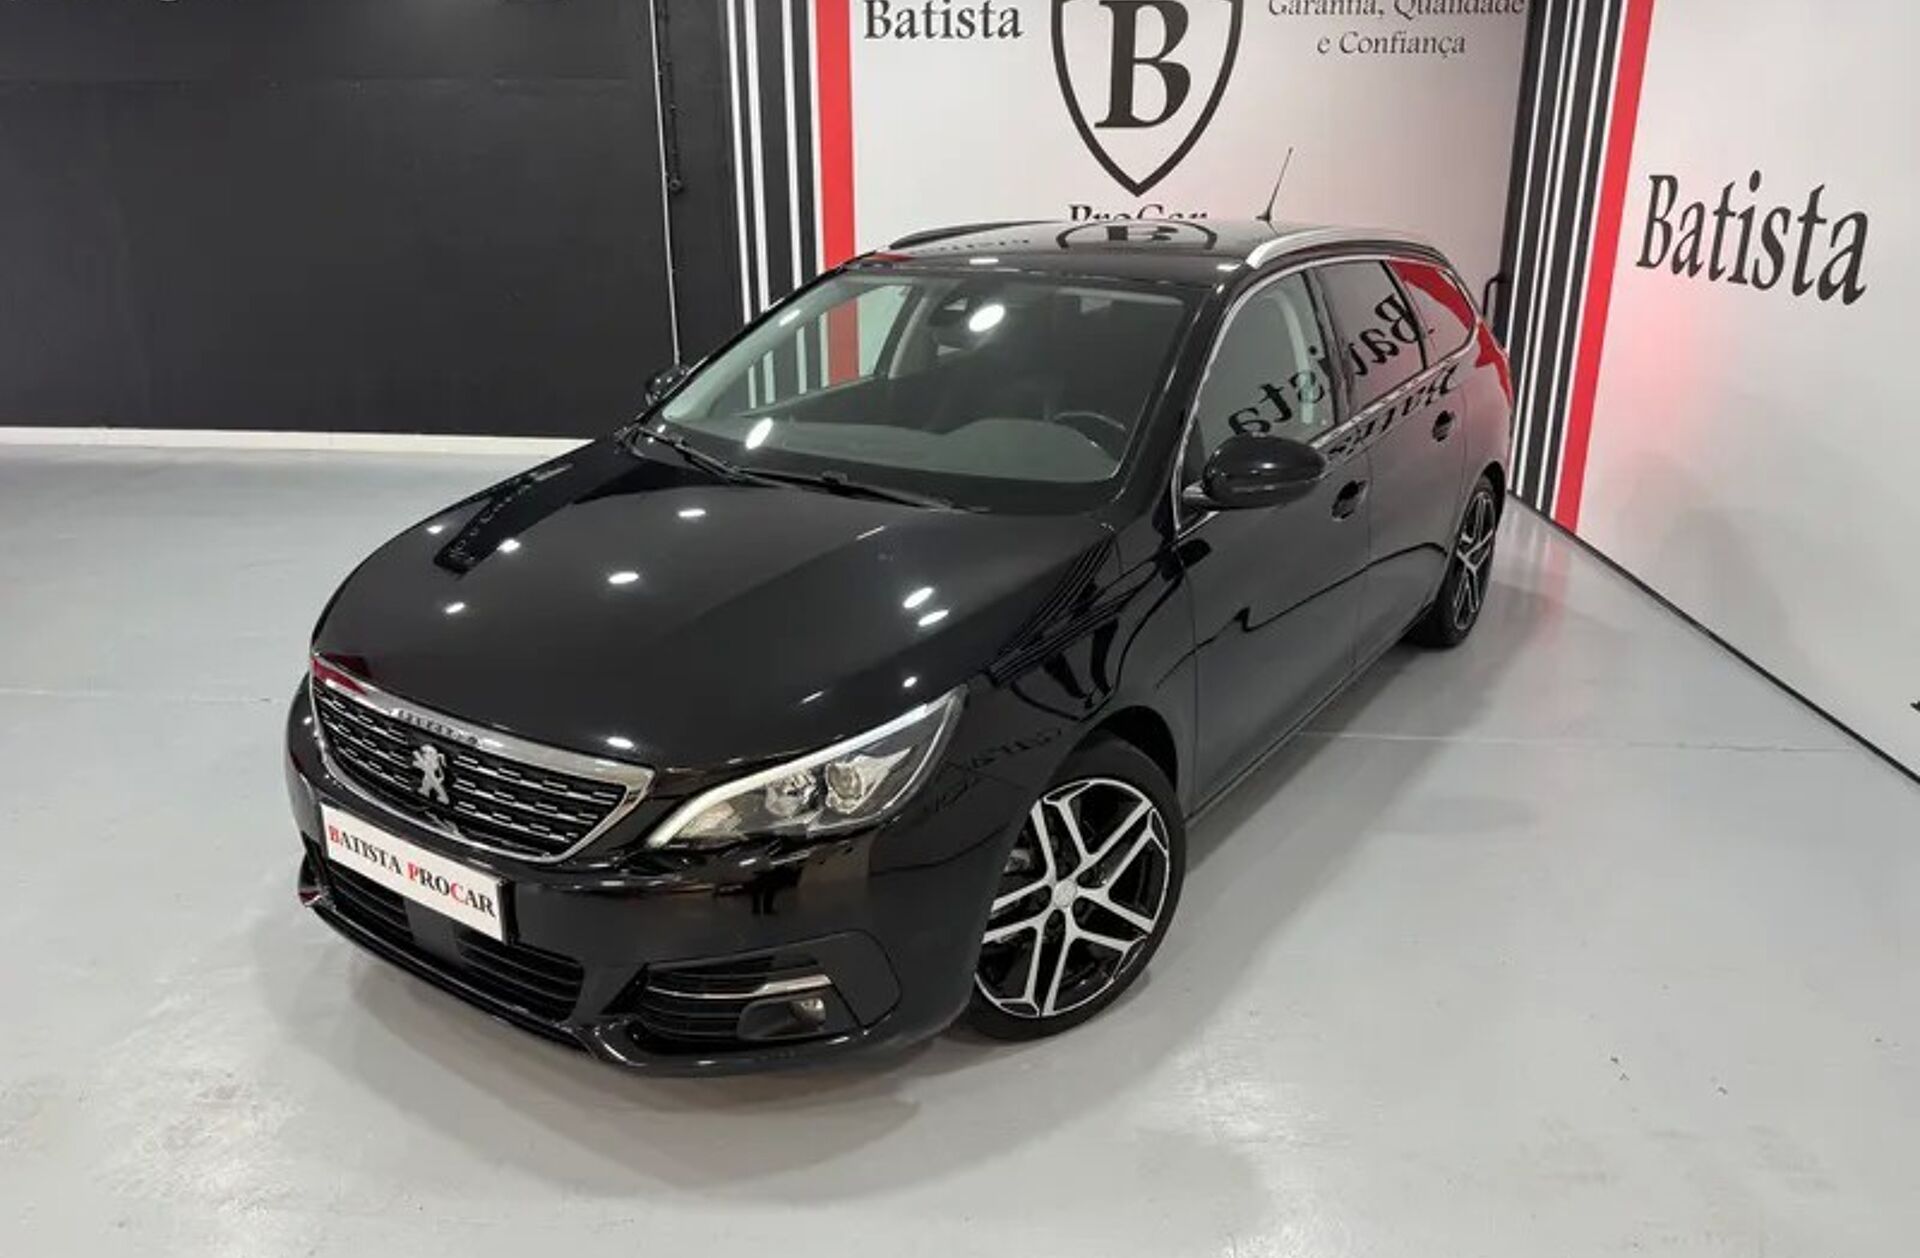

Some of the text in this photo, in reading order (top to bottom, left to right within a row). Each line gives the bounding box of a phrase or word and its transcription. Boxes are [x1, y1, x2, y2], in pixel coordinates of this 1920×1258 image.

[864, 0, 1024, 39] Batista
[1316, 30, 1466, 58] e Confiança
[1094, 0, 1191, 128] B
[1636, 170, 1868, 305] Batista
[328, 825, 403, 877] BATISTA
